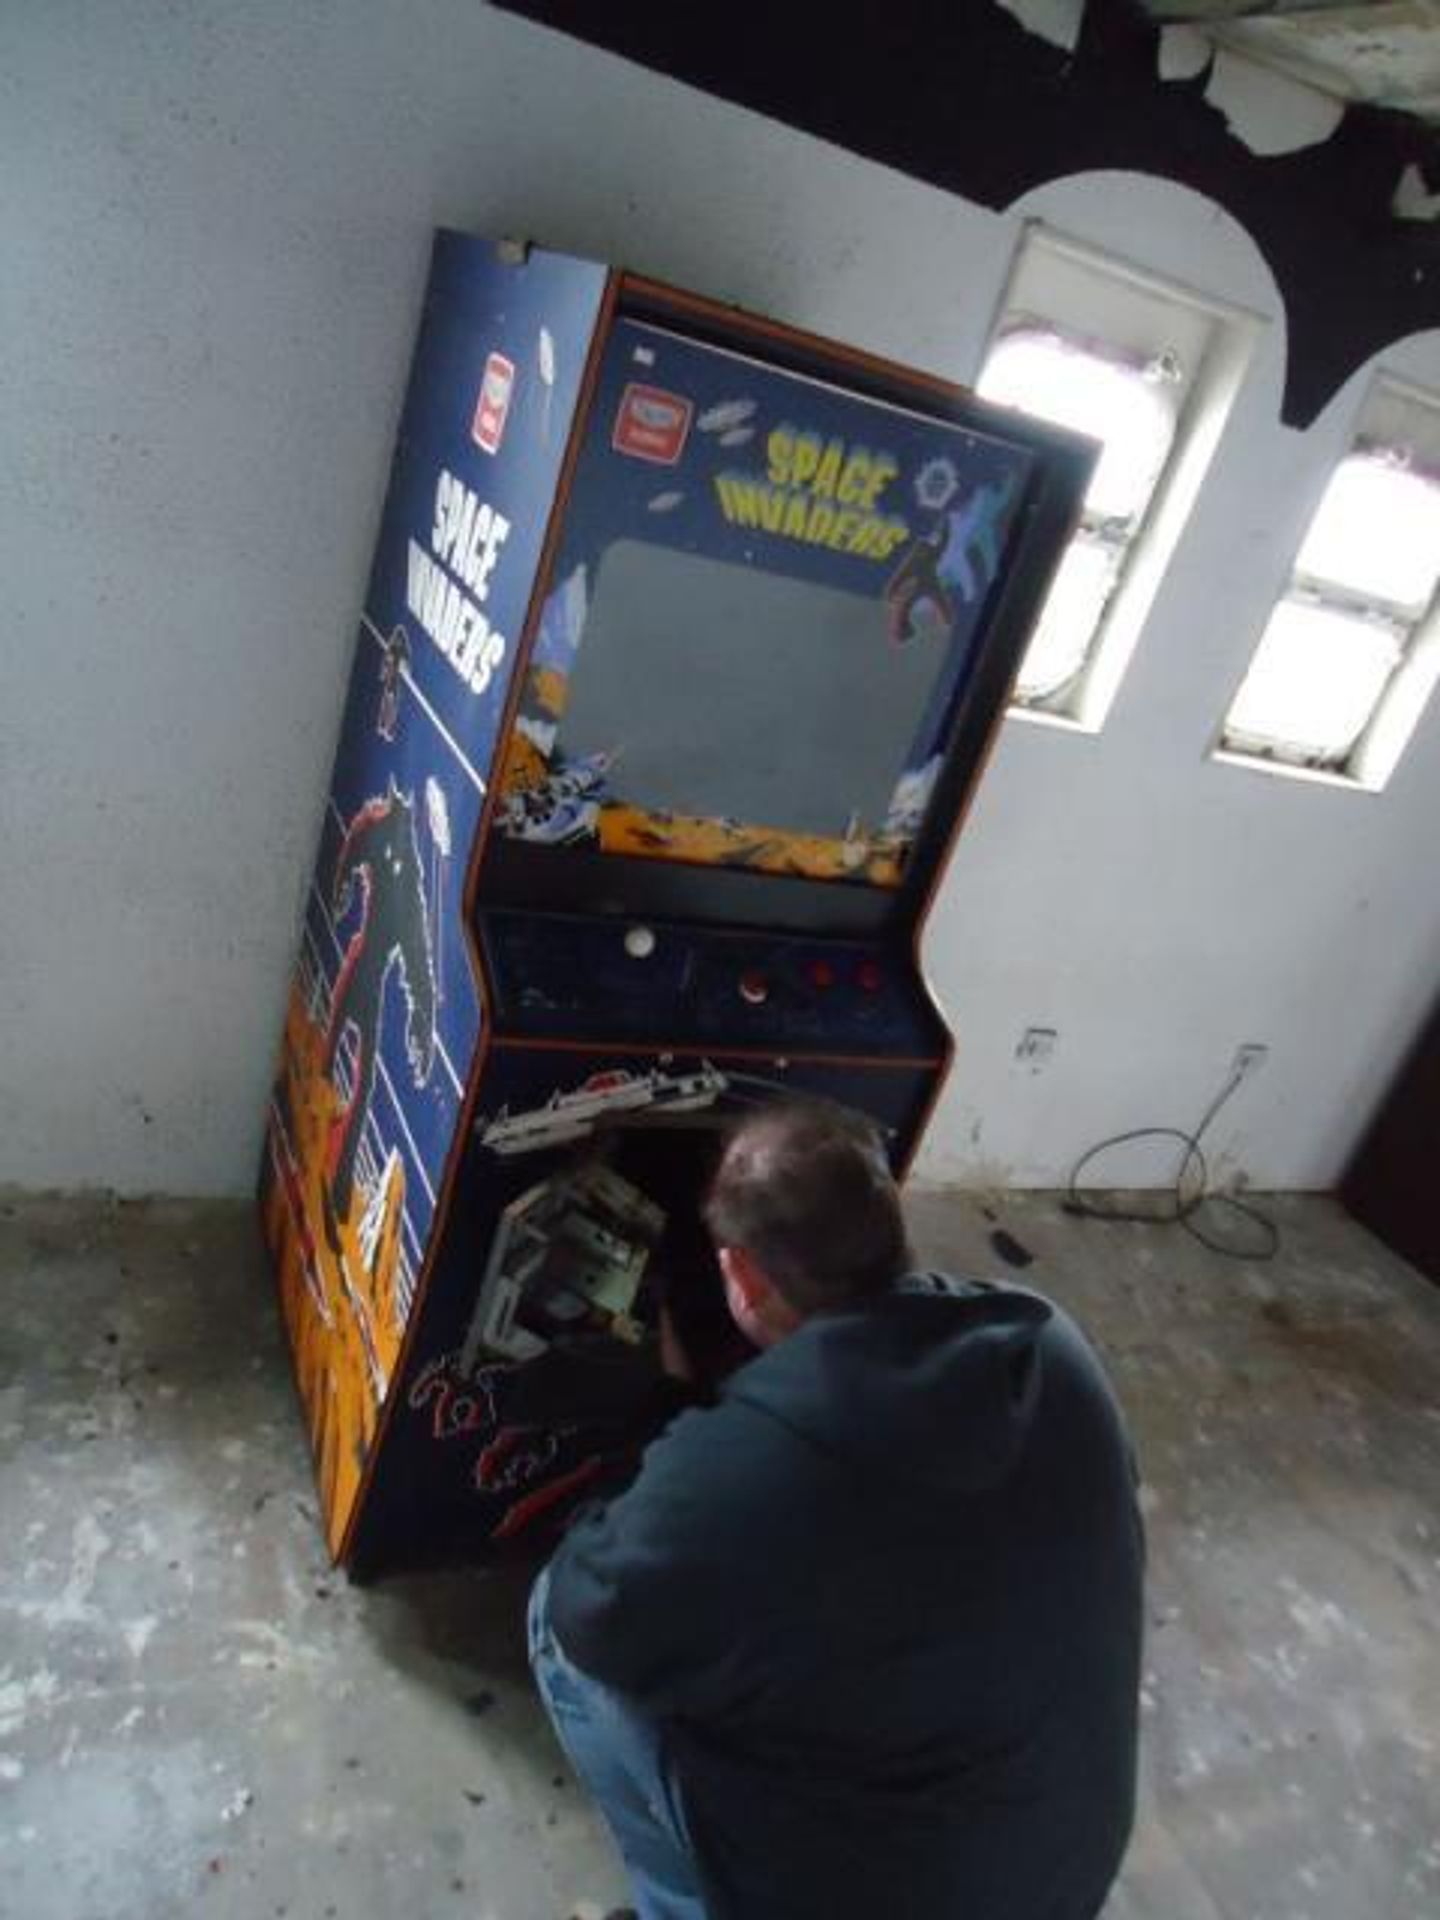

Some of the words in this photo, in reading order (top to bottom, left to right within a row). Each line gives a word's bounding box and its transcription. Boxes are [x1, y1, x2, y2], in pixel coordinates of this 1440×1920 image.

[714, 476, 910, 561] INVADERS
[767, 428, 898, 508] SPACE
[432, 468, 510, 602] SPACE
[407, 537, 505, 694] INVADERS
